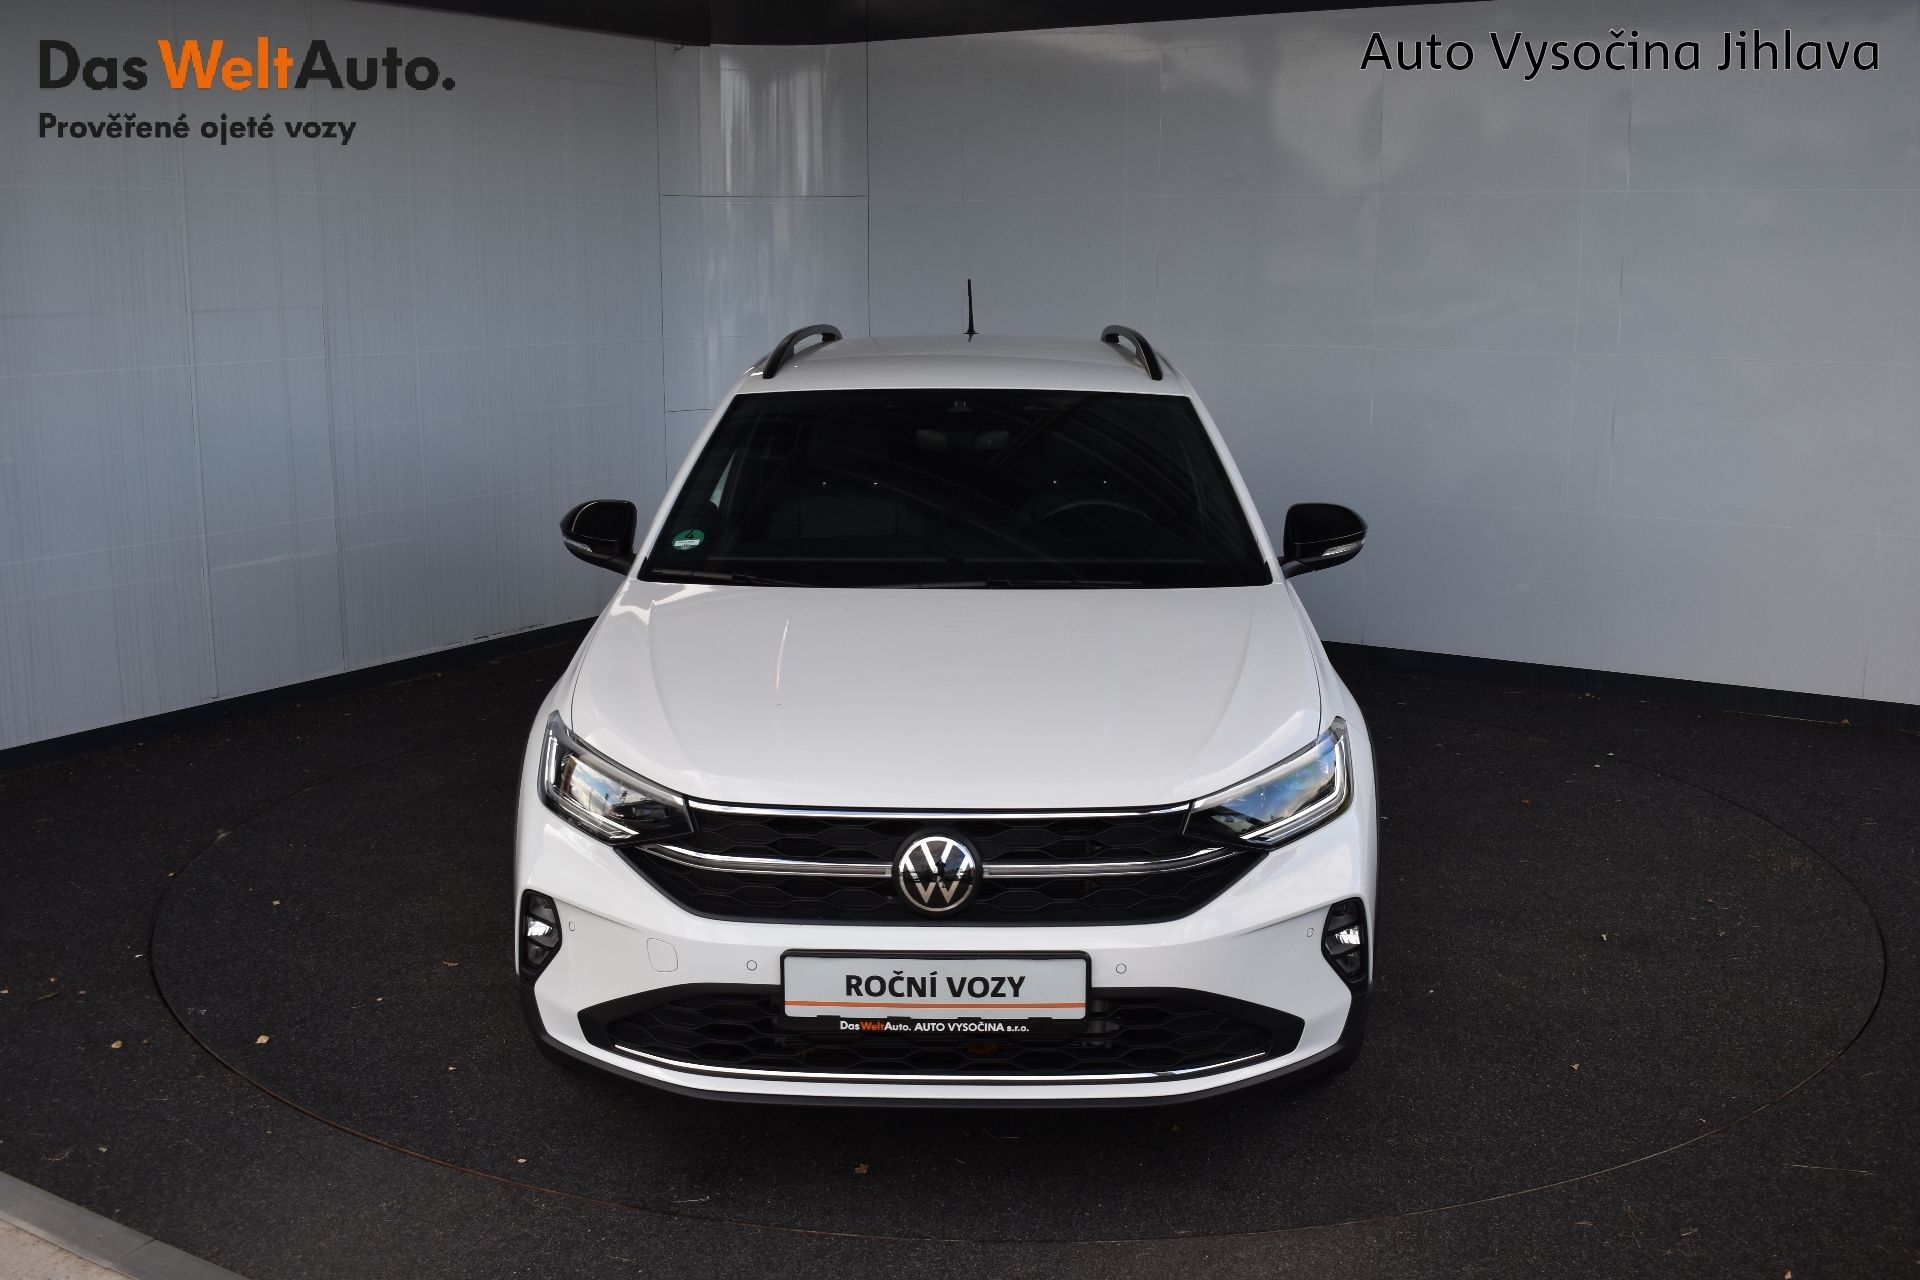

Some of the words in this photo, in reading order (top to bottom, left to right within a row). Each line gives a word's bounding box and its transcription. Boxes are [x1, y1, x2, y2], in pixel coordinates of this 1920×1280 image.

[845, 970, 938, 998] ROČNÍ
[946, 976, 1026, 998] VOZY
[914, 1022, 946, 1032] AUTO
[947, 1020, 1005, 1033] VYSOČINA
[1006, 1024, 1030, 1033] s.r.o.
